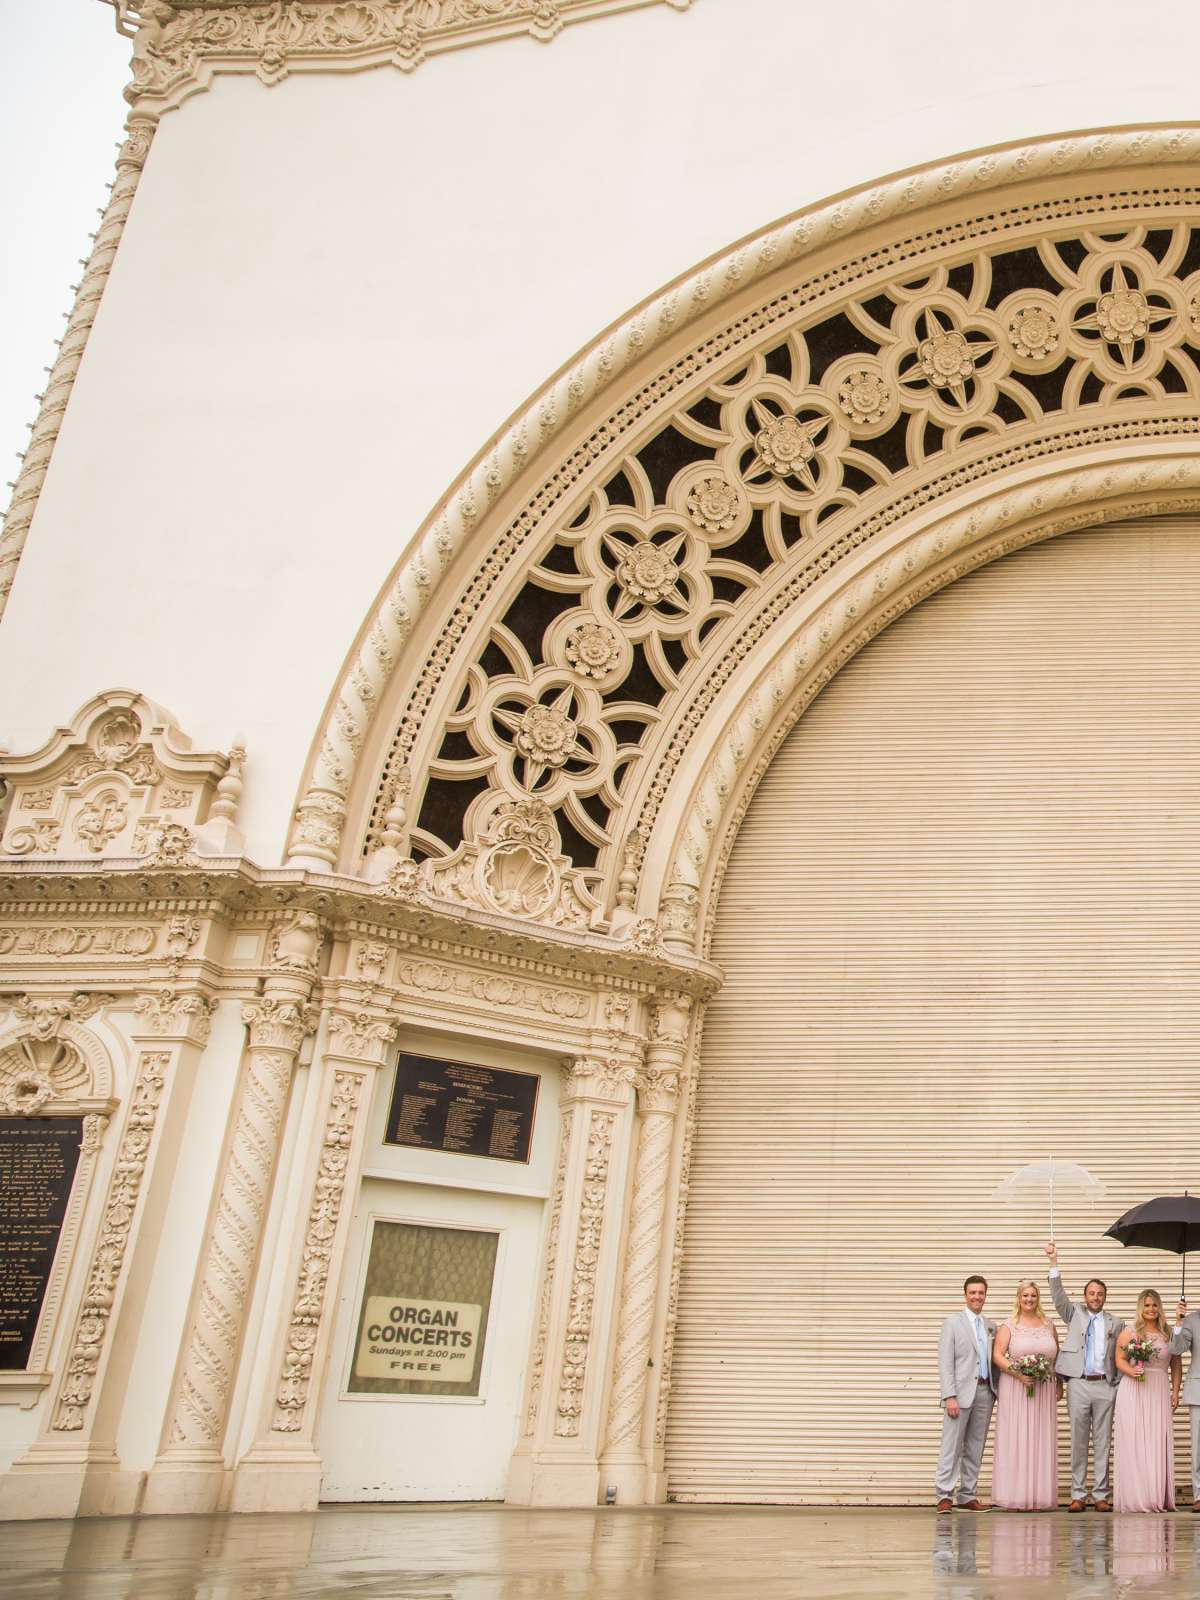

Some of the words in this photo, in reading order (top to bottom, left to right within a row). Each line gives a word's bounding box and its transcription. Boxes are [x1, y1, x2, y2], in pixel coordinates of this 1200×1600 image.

[390, 1306, 458, 1327] ORGAN
[367, 1324, 472, 1348] CONCERTS
[369, 1345, 412, 1357] Sundays
[414, 1349, 424, 1357] at
[426, 1349, 449, 1358] 2:00
[449, 1352, 466, 1360] pm
[390, 1361, 441, 1371] FREE
